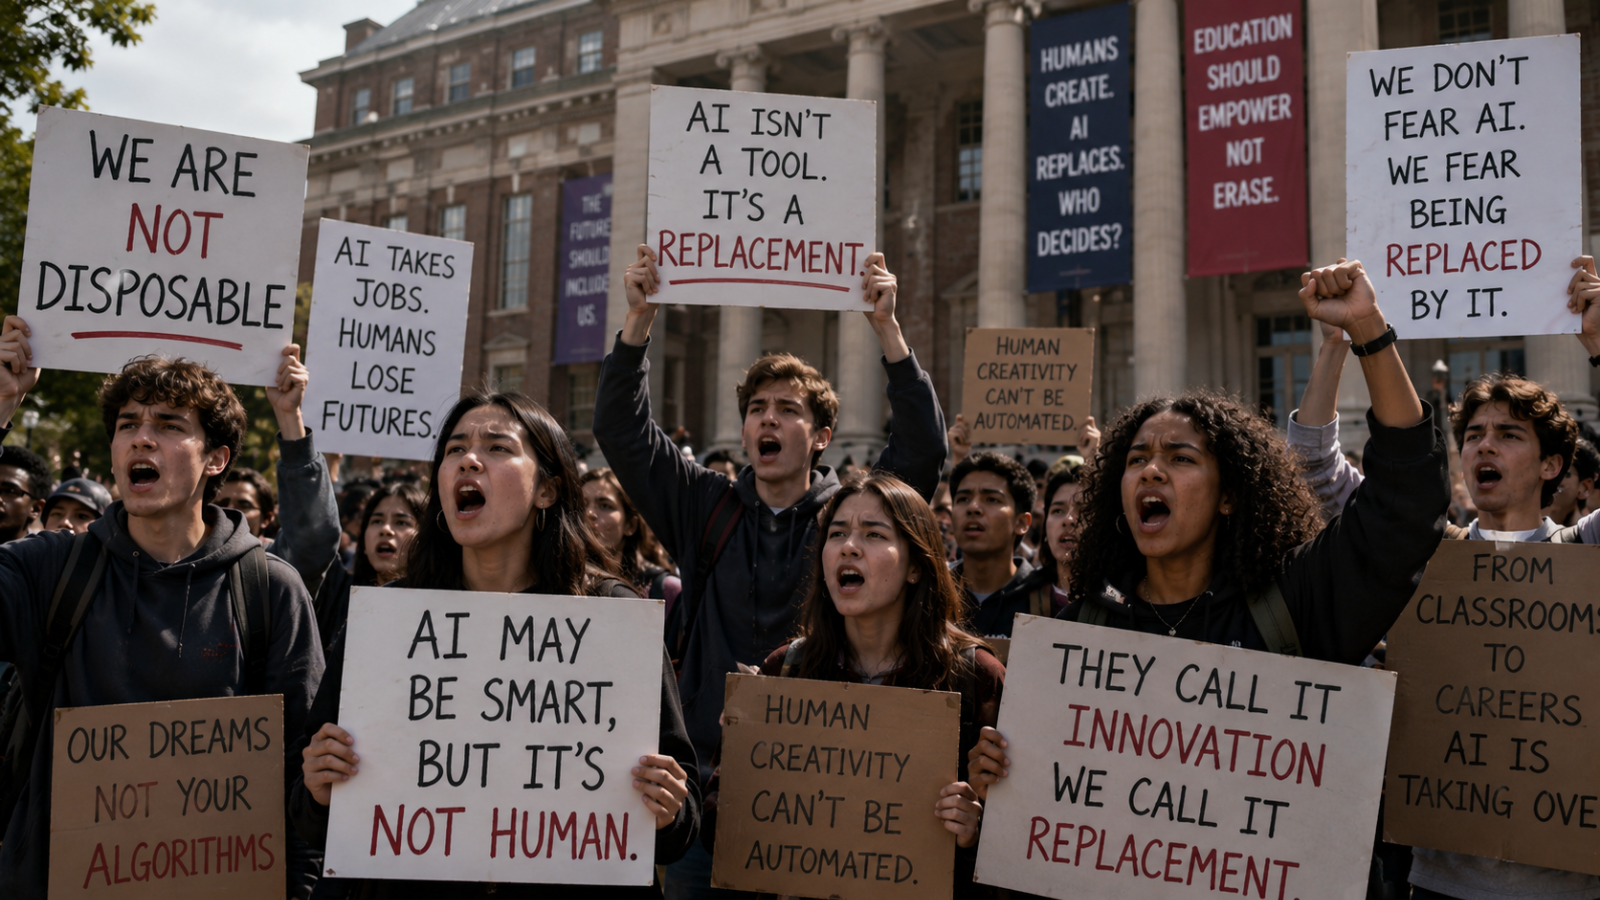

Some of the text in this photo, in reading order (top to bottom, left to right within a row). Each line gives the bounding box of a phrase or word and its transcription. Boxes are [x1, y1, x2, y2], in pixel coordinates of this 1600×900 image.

[1194, 14, 1292, 54] EDUCATION
[1041, 36, 1118, 72] HUMANS
[1207, 55, 1280, 90] SHOULD
[1045, 74, 1114, 107] CREATE.
[1369, 54, 1529, 97] WE DON'T
[686, 101, 831, 139] AI ISN'T
[1070, 115, 1088, 140] AI
[1199, 93, 1291, 131] EMPOWER
[1385, 101, 1525, 141] FEAR AI.
[90, 130, 258, 197] WE ARE
[700, 144, 826, 181] A TOOL.
[1037, 145, 1124, 180] REPLACES.
[1227, 137, 1264, 166] NOT
[1388, 149, 1520, 185] WE FEAR
[582, 193, 602, 214] THE
[703, 188, 804, 225] IT'S A
[1059, 187, 1100, 215] WHO
[1214, 177, 1279, 209] ERASE.
[1410, 195, 1506, 229] BEING
[126, 203, 223, 259] NOT
[569, 218, 611, 241] FUTURE
[1038, 223, 1122, 256] DECIDES?
[334, 236, 454, 279] AI TAKES
[569, 246, 610, 269] SHOULD
[658, 230, 865, 277] REPLACEMENT.
[1387, 239, 1541, 277] REPLACED
[36, 261, 286, 329] DISPOSABLE
[353, 278, 428, 313] JOBS.
[1411, 287, 1507, 320] BY IT.
[577, 304, 598, 326] US.
[339, 317, 436, 356] HUMANS
[996, 336, 1060, 356] HUMAN
[351, 361, 415, 394] LOSE
[977, 362, 1077, 381] CREATIVITY
[985, 387, 1064, 406] CAN'T BE
[322, 400, 437, 439] FUTURES.
[973, 412, 1078, 432] AUTOMATED.
[1472, 553, 1553, 584] FROM
[1416, 594, 1600, 634] CLASSROOM
[407, 610, 591, 664] AI MAY
[1484, 643, 1525, 673] TO
[1053, 643, 1341, 724] THEY CALL IT
[408, 674, 616, 732] BE SMART,
[765, 694, 870, 730] HUMAN
[1435, 684, 1582, 726] CAREERS
[67, 717, 270, 764] OUR DREAMS
[1063, 704, 1326, 787] INNOVATION
[1444, 731, 1549, 774] AI IS
[417, 740, 604, 791] BUT IT'S
[750, 741, 910, 782] CREATIVITY
[94, 775, 252, 823] NOT YOUR
[751, 790, 902, 835] CAN'T BE
[1054, 762, 1290, 838] WE CALL IT
[1398, 774, 1514, 819] TAKING
[370, 804, 637, 861] NOT HUMAN.
[83, 833, 275, 889] ALGORITHMS
[746, 841, 918, 885] AUTOMATED.
